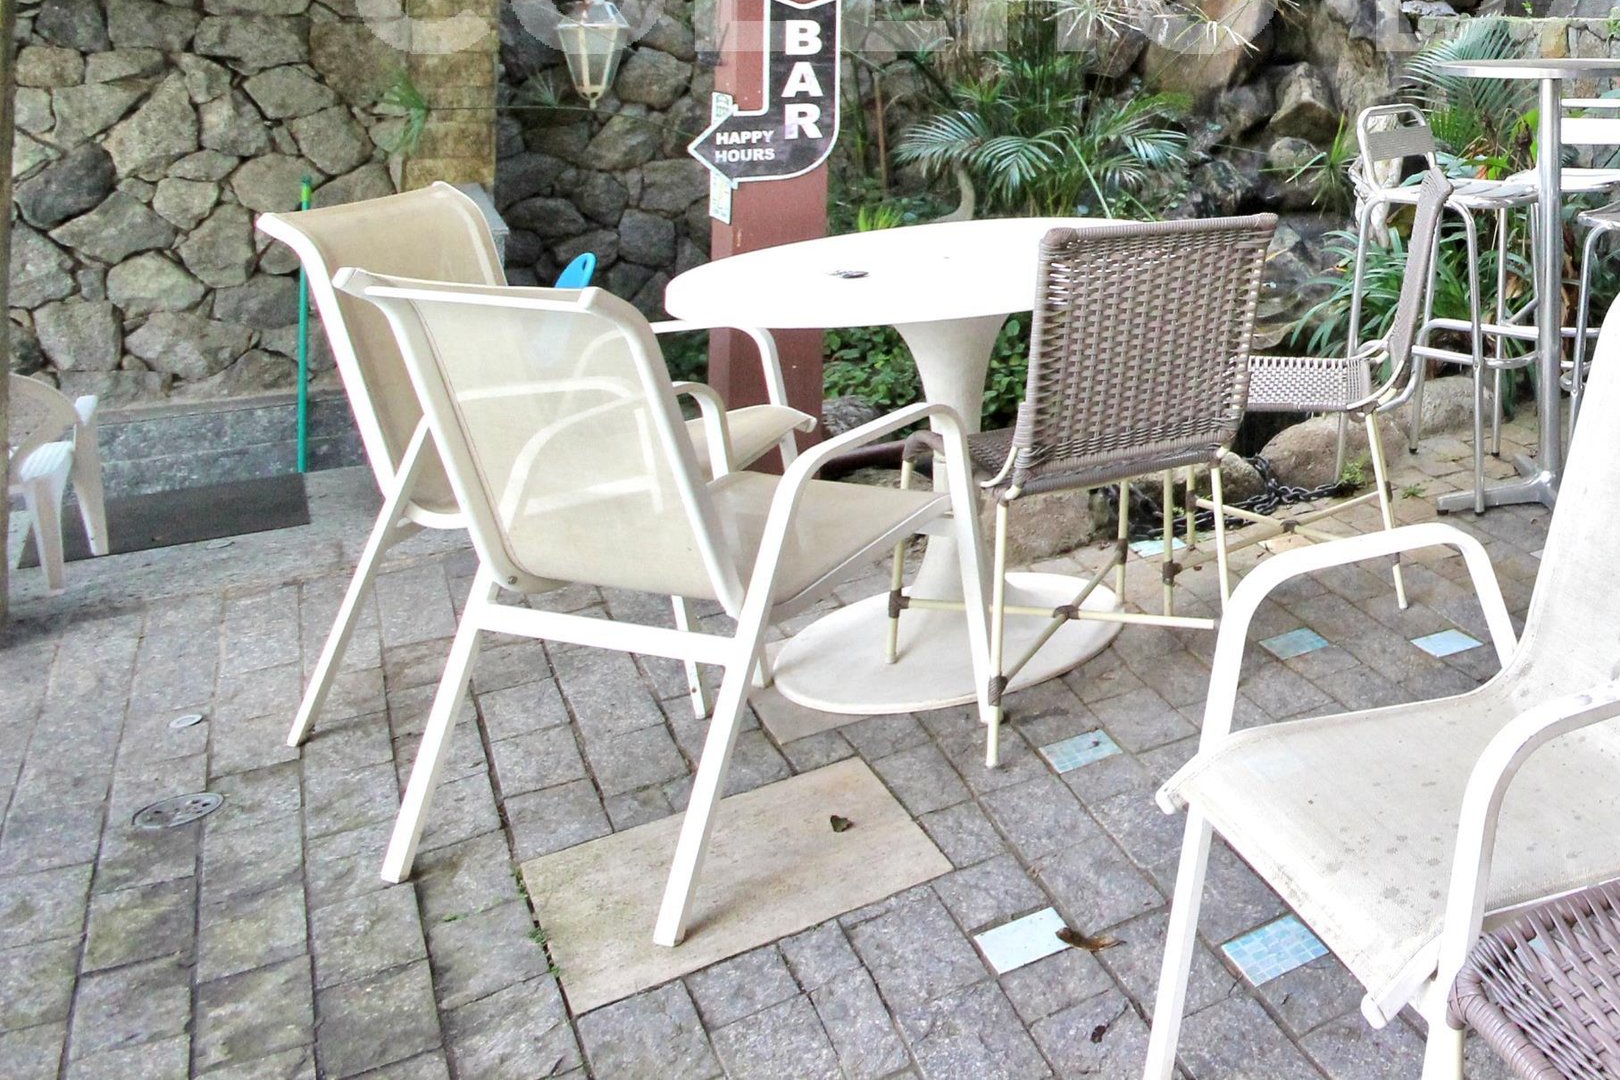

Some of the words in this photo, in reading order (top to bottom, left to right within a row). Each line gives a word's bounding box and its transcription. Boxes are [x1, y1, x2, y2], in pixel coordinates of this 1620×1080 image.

[781, 20, 823, 140] BAR
[715, 130, 774, 146] HAPPY
[714, 148, 776, 164] HOURS
